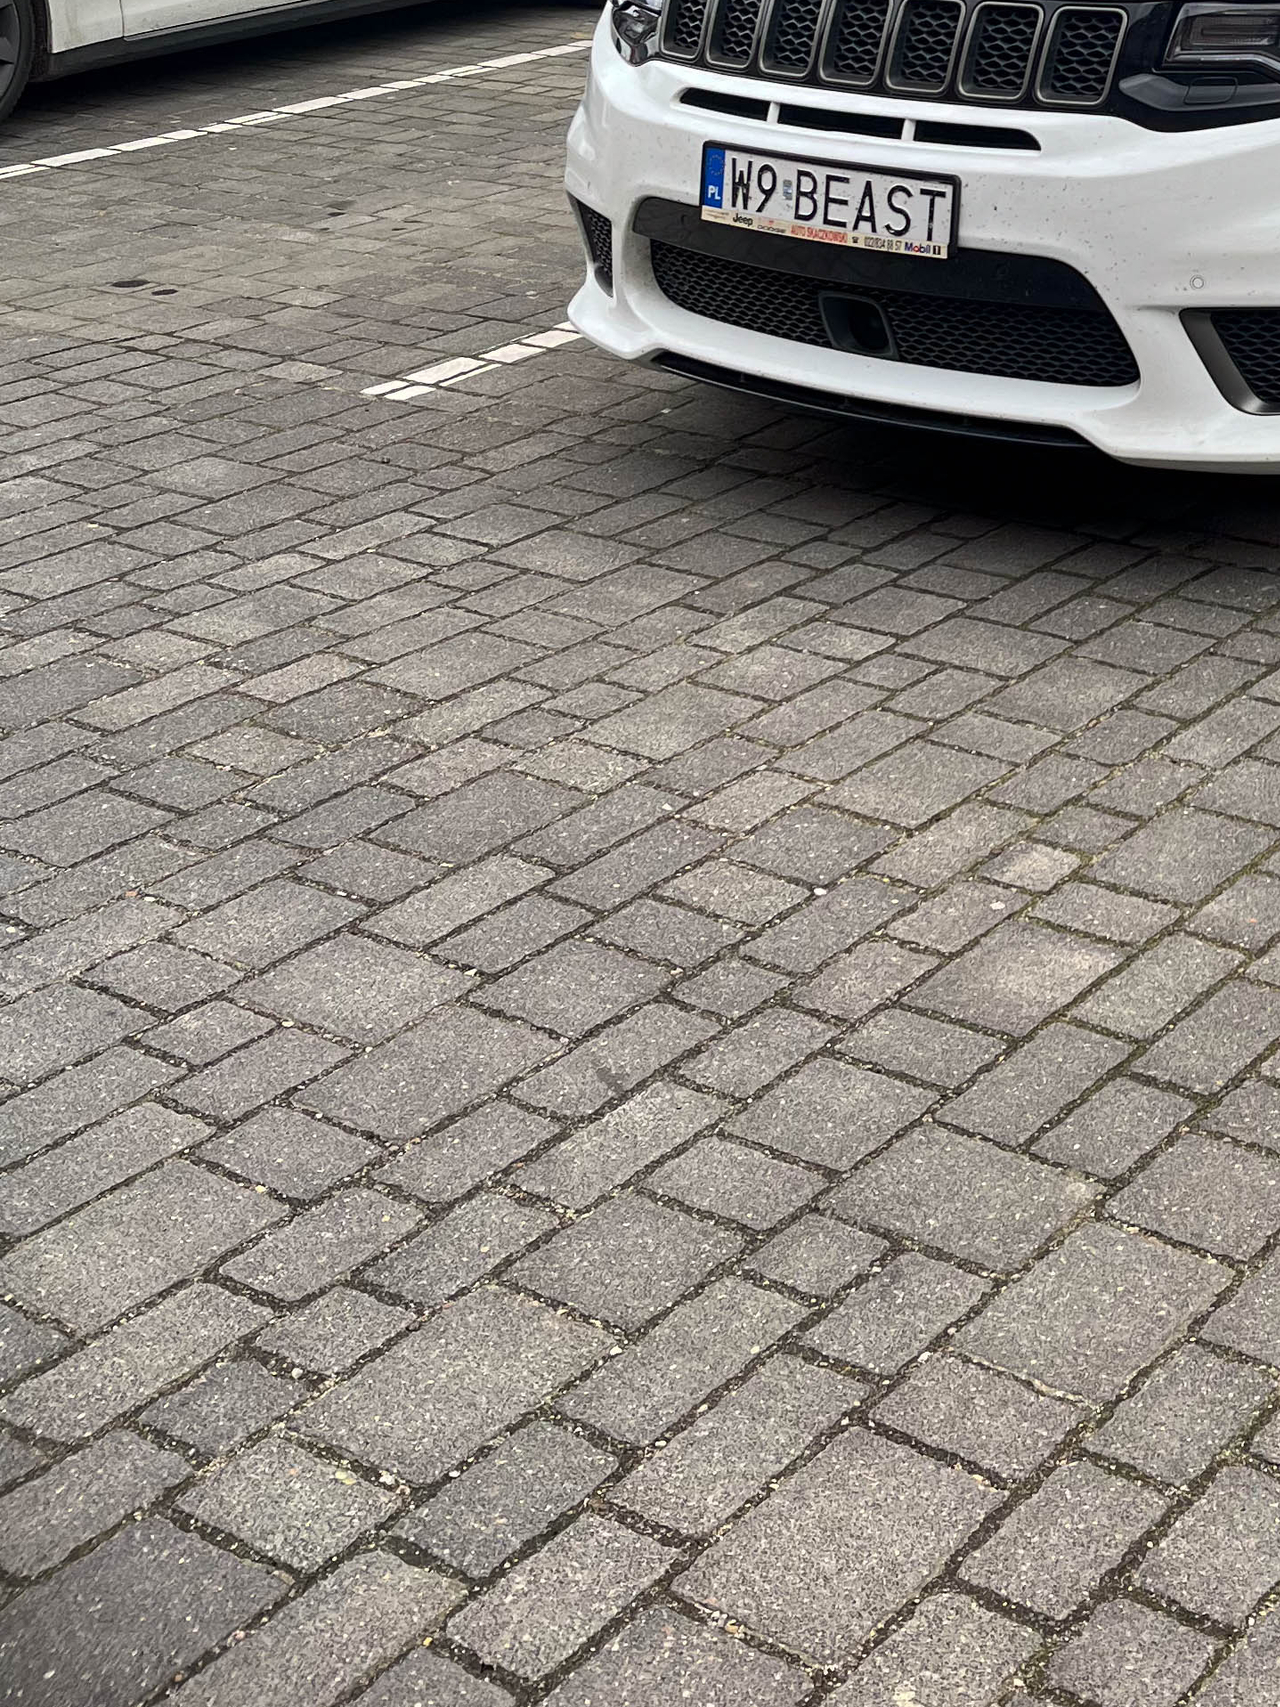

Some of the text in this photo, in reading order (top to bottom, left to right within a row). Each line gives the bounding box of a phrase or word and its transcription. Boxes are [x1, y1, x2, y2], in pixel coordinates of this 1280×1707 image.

[707, 184, 721, 200] PL
[731, 157, 947, 242] W9 BEAST
[732, 213, 754, 227] Jeep
[904, 242, 931, 255] Mobil
